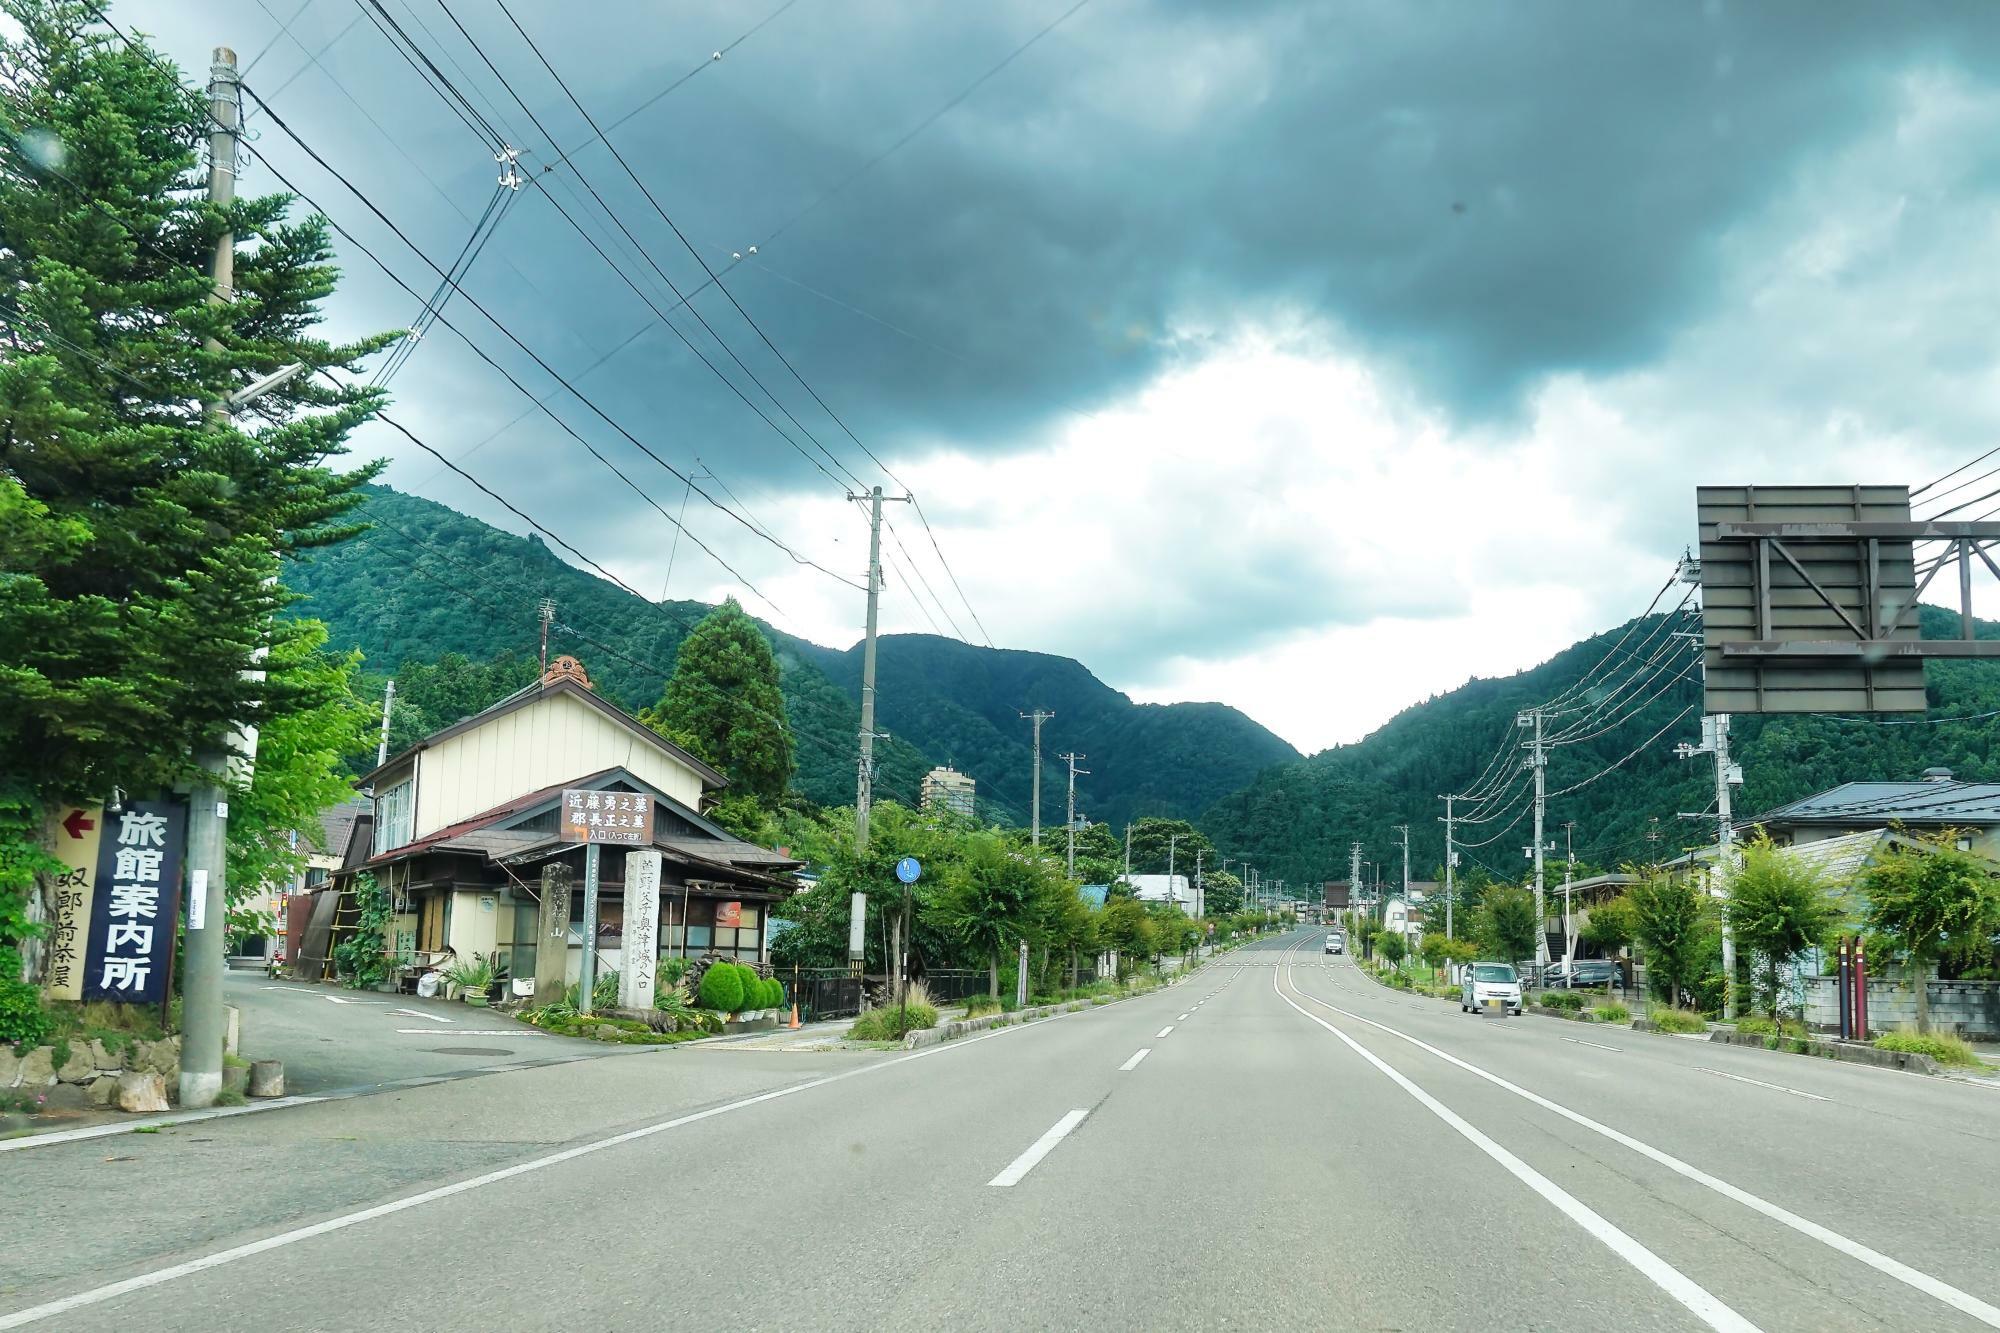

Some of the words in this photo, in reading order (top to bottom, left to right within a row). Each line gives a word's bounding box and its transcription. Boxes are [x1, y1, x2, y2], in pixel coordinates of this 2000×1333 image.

[569, 794, 648, 813] 近藤勇之墓
[570, 812, 645, 829] 郡長正之墓
[100, 811, 168, 991] 旅館案内所
